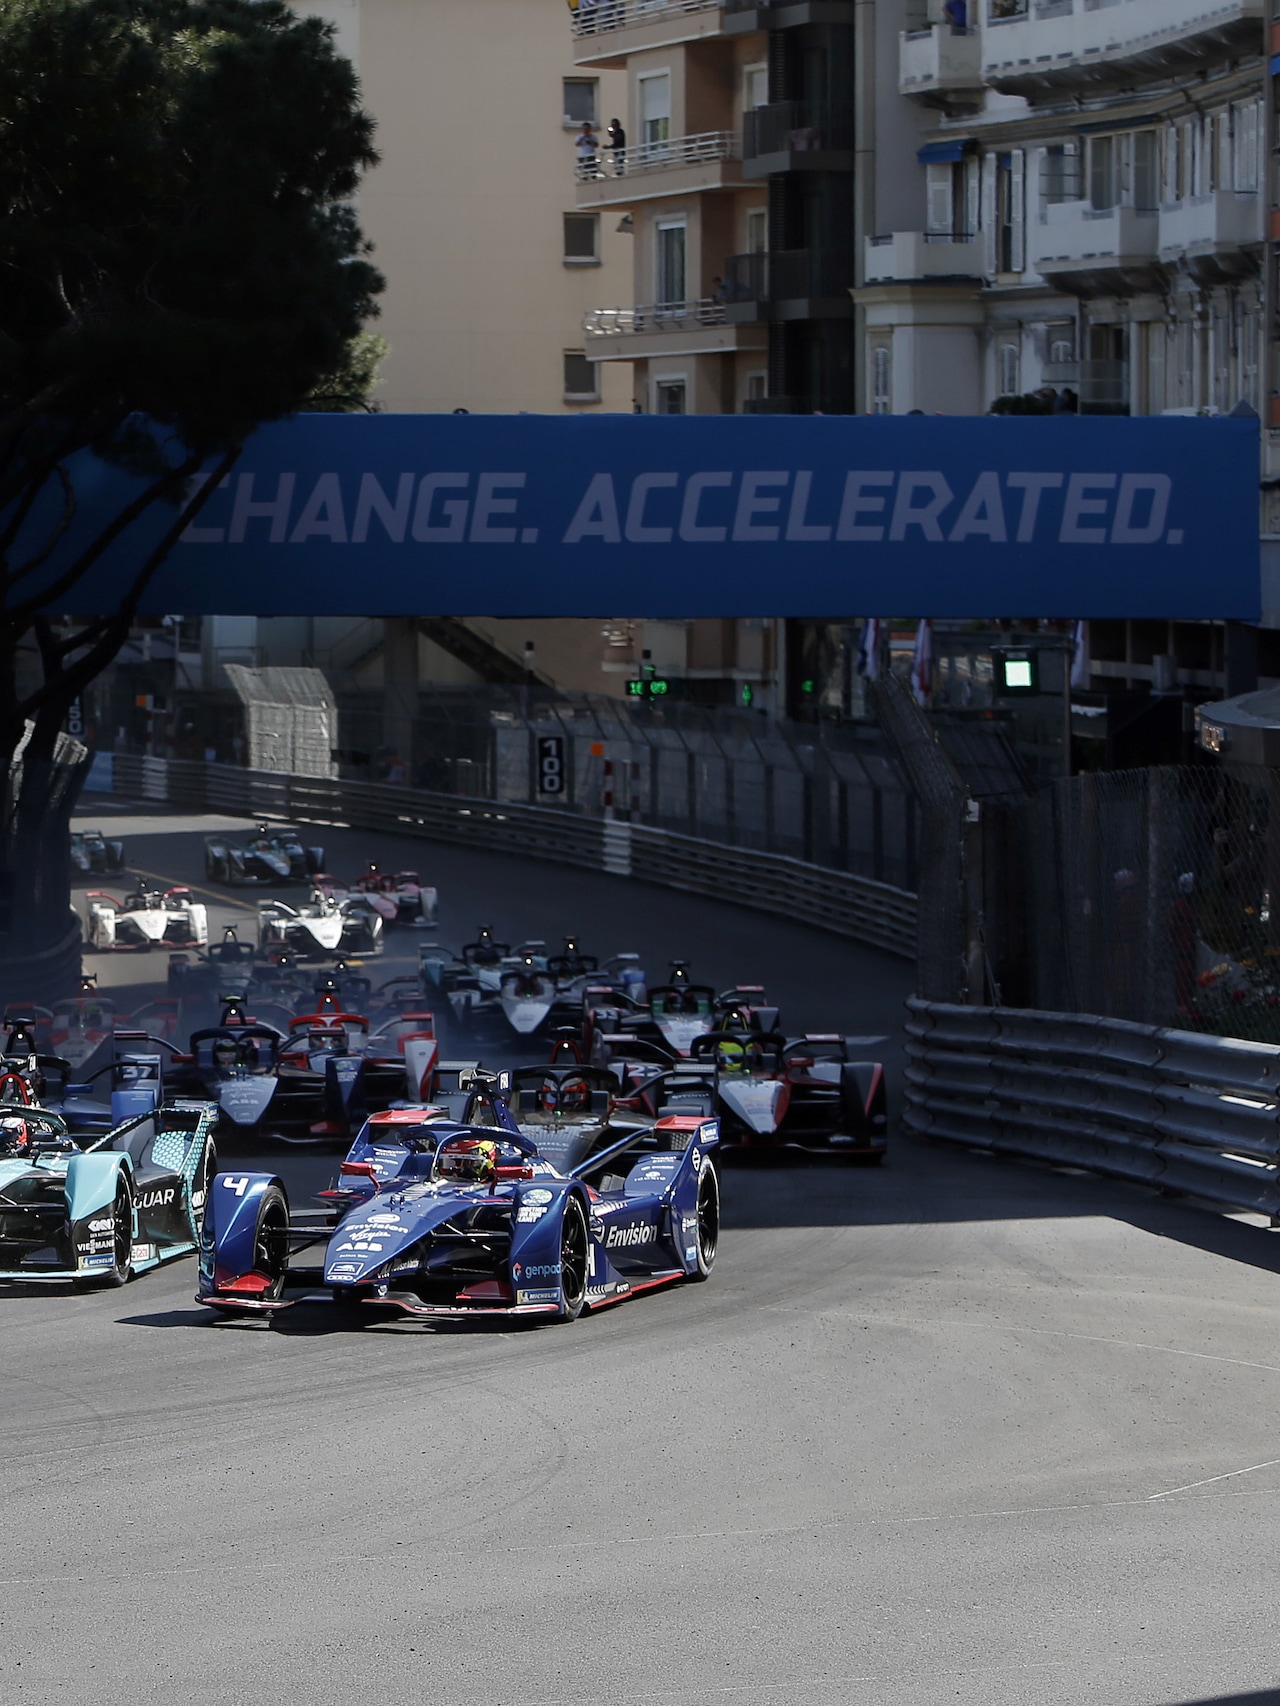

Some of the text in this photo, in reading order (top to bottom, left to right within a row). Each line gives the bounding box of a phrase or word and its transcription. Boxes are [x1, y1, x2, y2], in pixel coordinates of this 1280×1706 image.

[179, 470, 1184, 545] CHANGE. ACCELERATED.
[542, 739, 561, 792] 100
[122, 1065, 153, 1080] 37
[224, 1177, 249, 1196] 4
[606, 1220, 658, 1249] Envision
[336, 1242, 383, 1252] ABB
